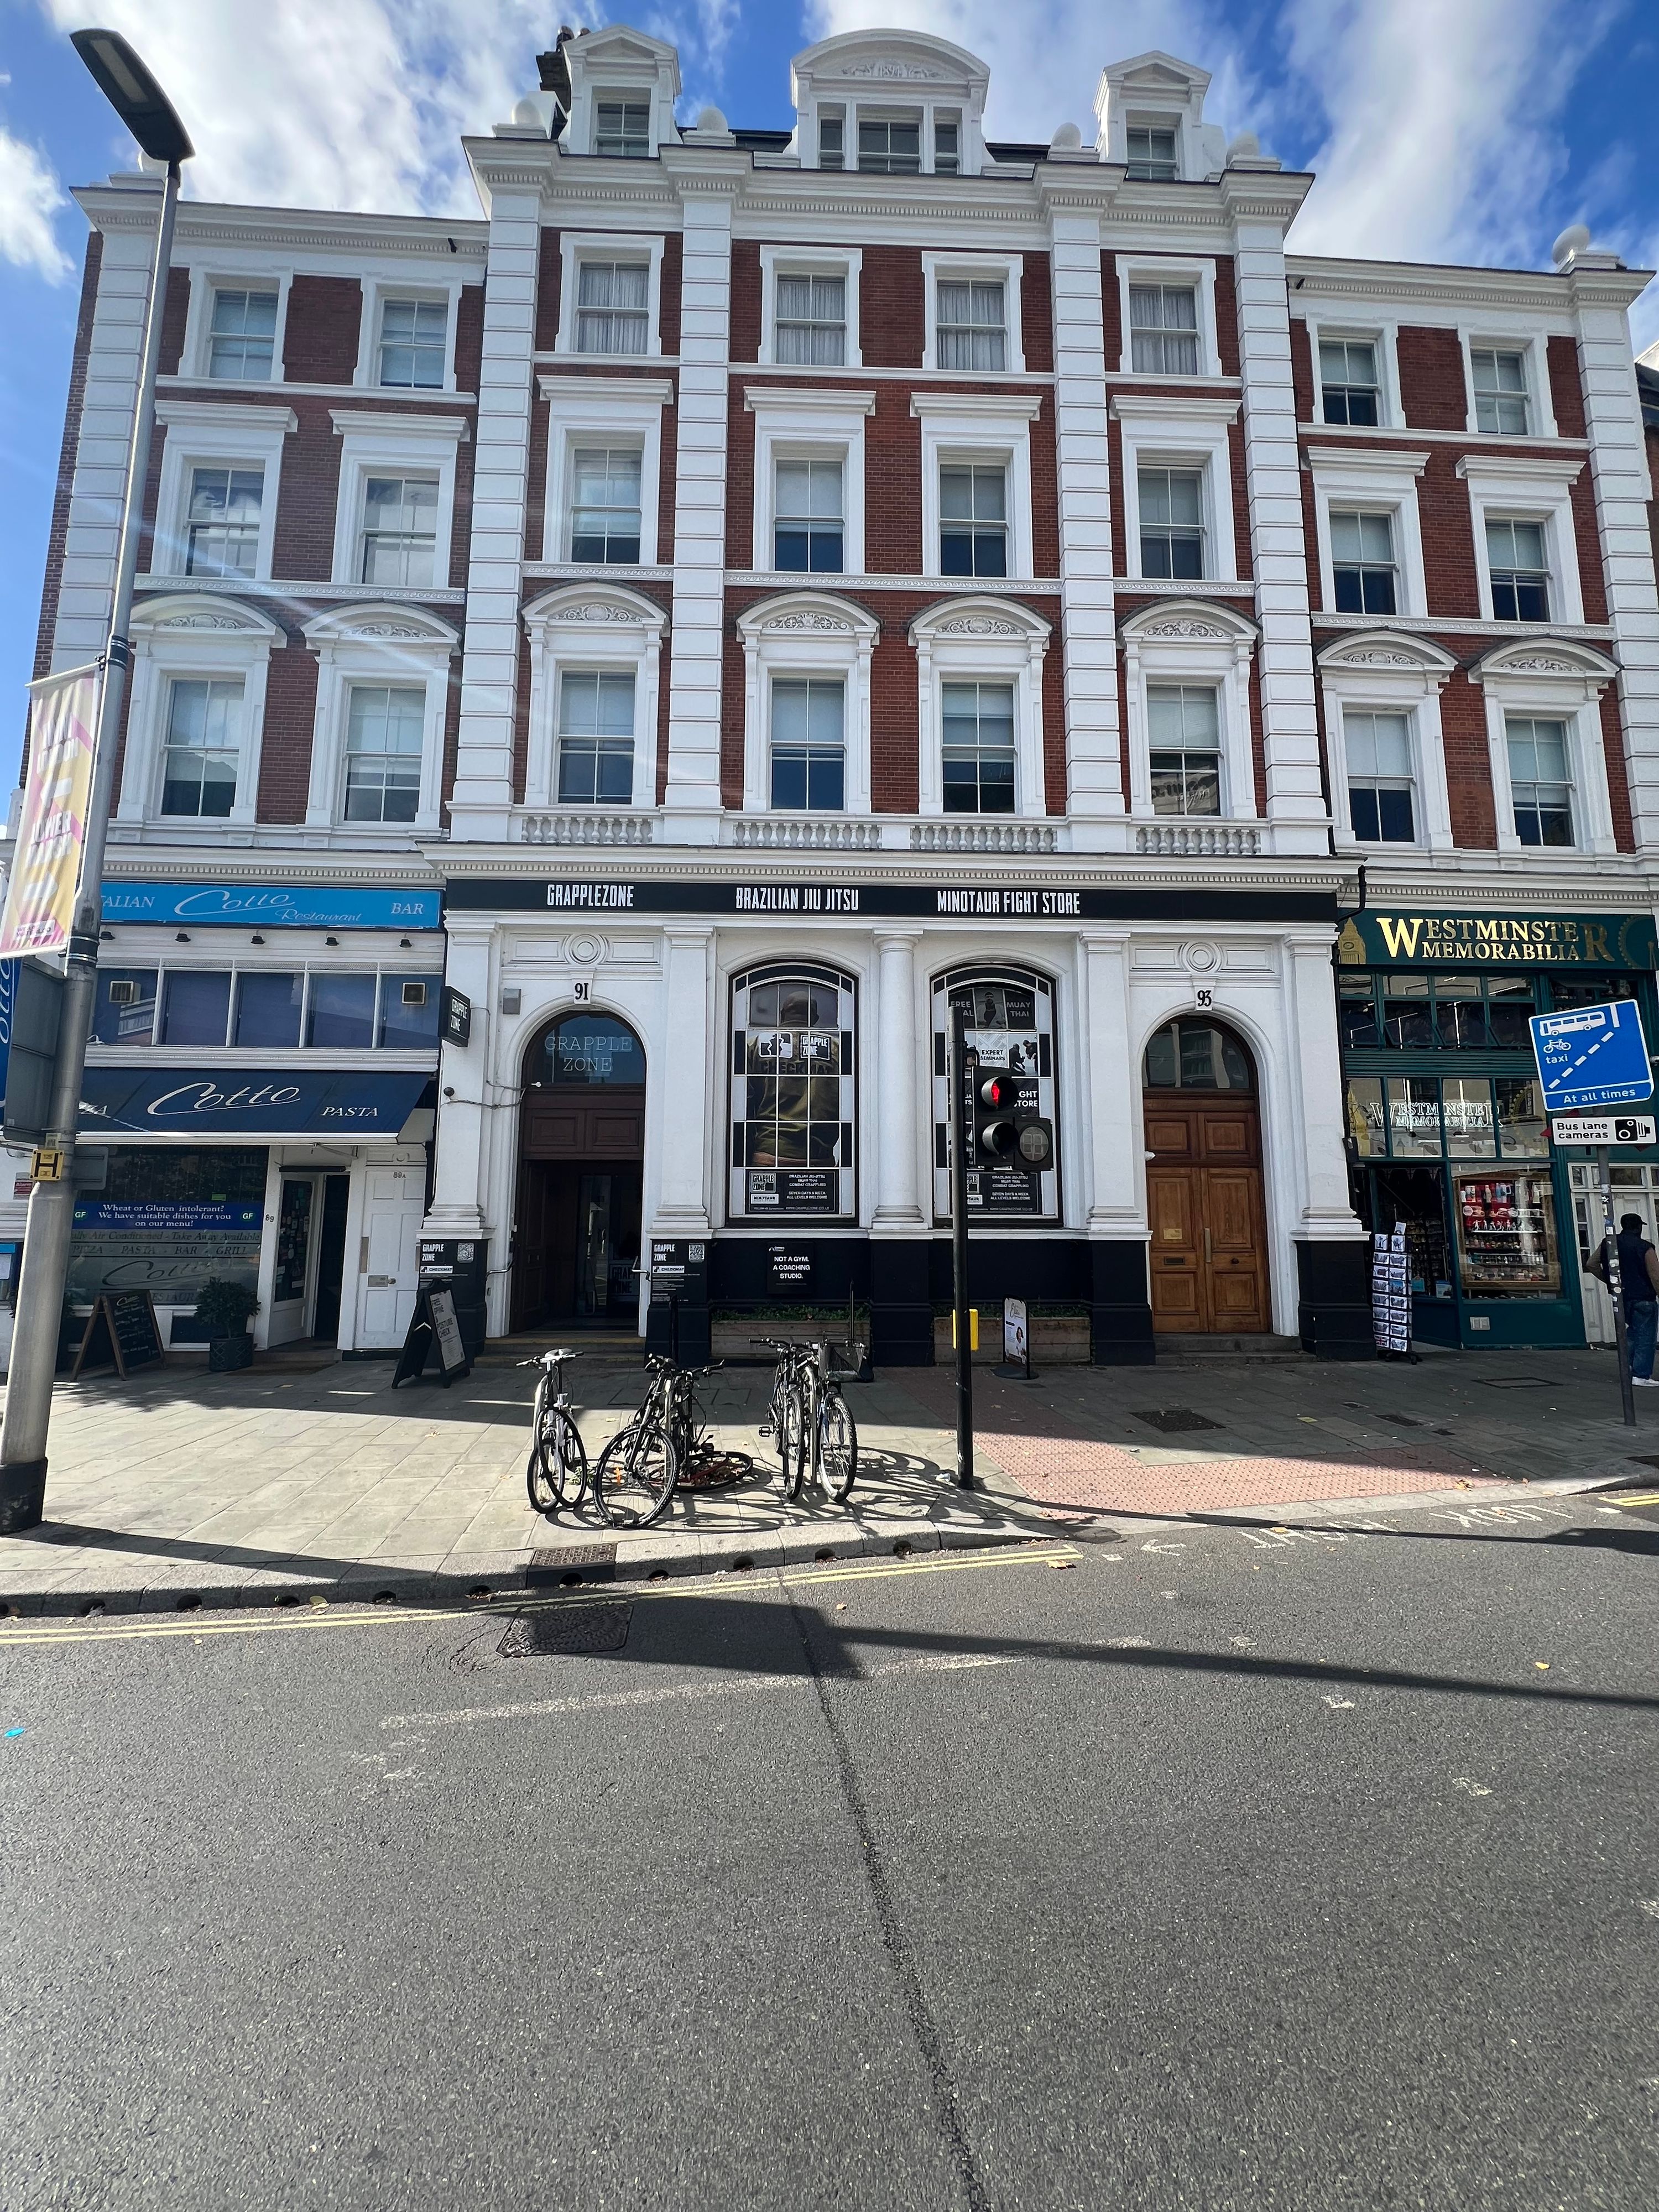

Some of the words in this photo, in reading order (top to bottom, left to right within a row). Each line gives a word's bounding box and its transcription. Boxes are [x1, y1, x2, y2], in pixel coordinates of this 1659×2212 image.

[101, 895, 155, 907] ALIAN
[174, 890, 295, 916] Cotto
[547, 884, 634, 907] GRAPPLEZONE
[736, 888, 799, 910] BRAZILIAN
[802, 889, 821, 910] JIU
[825, 889, 859, 911] JITSU
[937, 891, 999, 913] MINOTAUR
[1004, 892, 1039, 914] FIGHT
[1042, 893, 1080, 914] STORE
[275, 909, 362, 922] Restaurant
[390, 902, 424, 915] BAR
[1376, 917, 1615, 962] WESTMINSTER
[1422, 942, 1582, 961] MEMORABILIA
[1197, 990, 1212, 1006] 93
[451, 999, 467, 1019] GRAPPLE
[451, 1015, 461, 1031] ZONE
[544, 1036, 633, 1051] GRAPPLE
[564, 1057, 612, 1072] ZONE
[1546, 1053, 1569, 1065] taxi
[147, 1082, 301, 1116] Cotto
[1563, 1094, 1579, 1104] At
[1582, 1092, 1597, 1102] all
[1600, 1088, 1636, 1100] times
[321, 1106, 378, 1117] PASTA
[1370, 1102, 1503, 1128] WESTMNSTER
[1557, 1121, 1578, 1132] Bus
[1583, 1121, 1608, 1131] lane
[1558, 1130, 1609, 1140] cameras
[265, 1214, 274, 1223] 89
[121, 1245, 156, 1254] PASTA
[175, 1246, 198, 1255] BAR
[216, 1246, 248, 1255] GRILL
[422, 1244, 444, 1252] GRAPPLE
[654, 1244, 675, 1252] GRAPPLE
[422, 1253, 435, 1261] ZONE
[654, 1253, 667, 1261] ZONE
